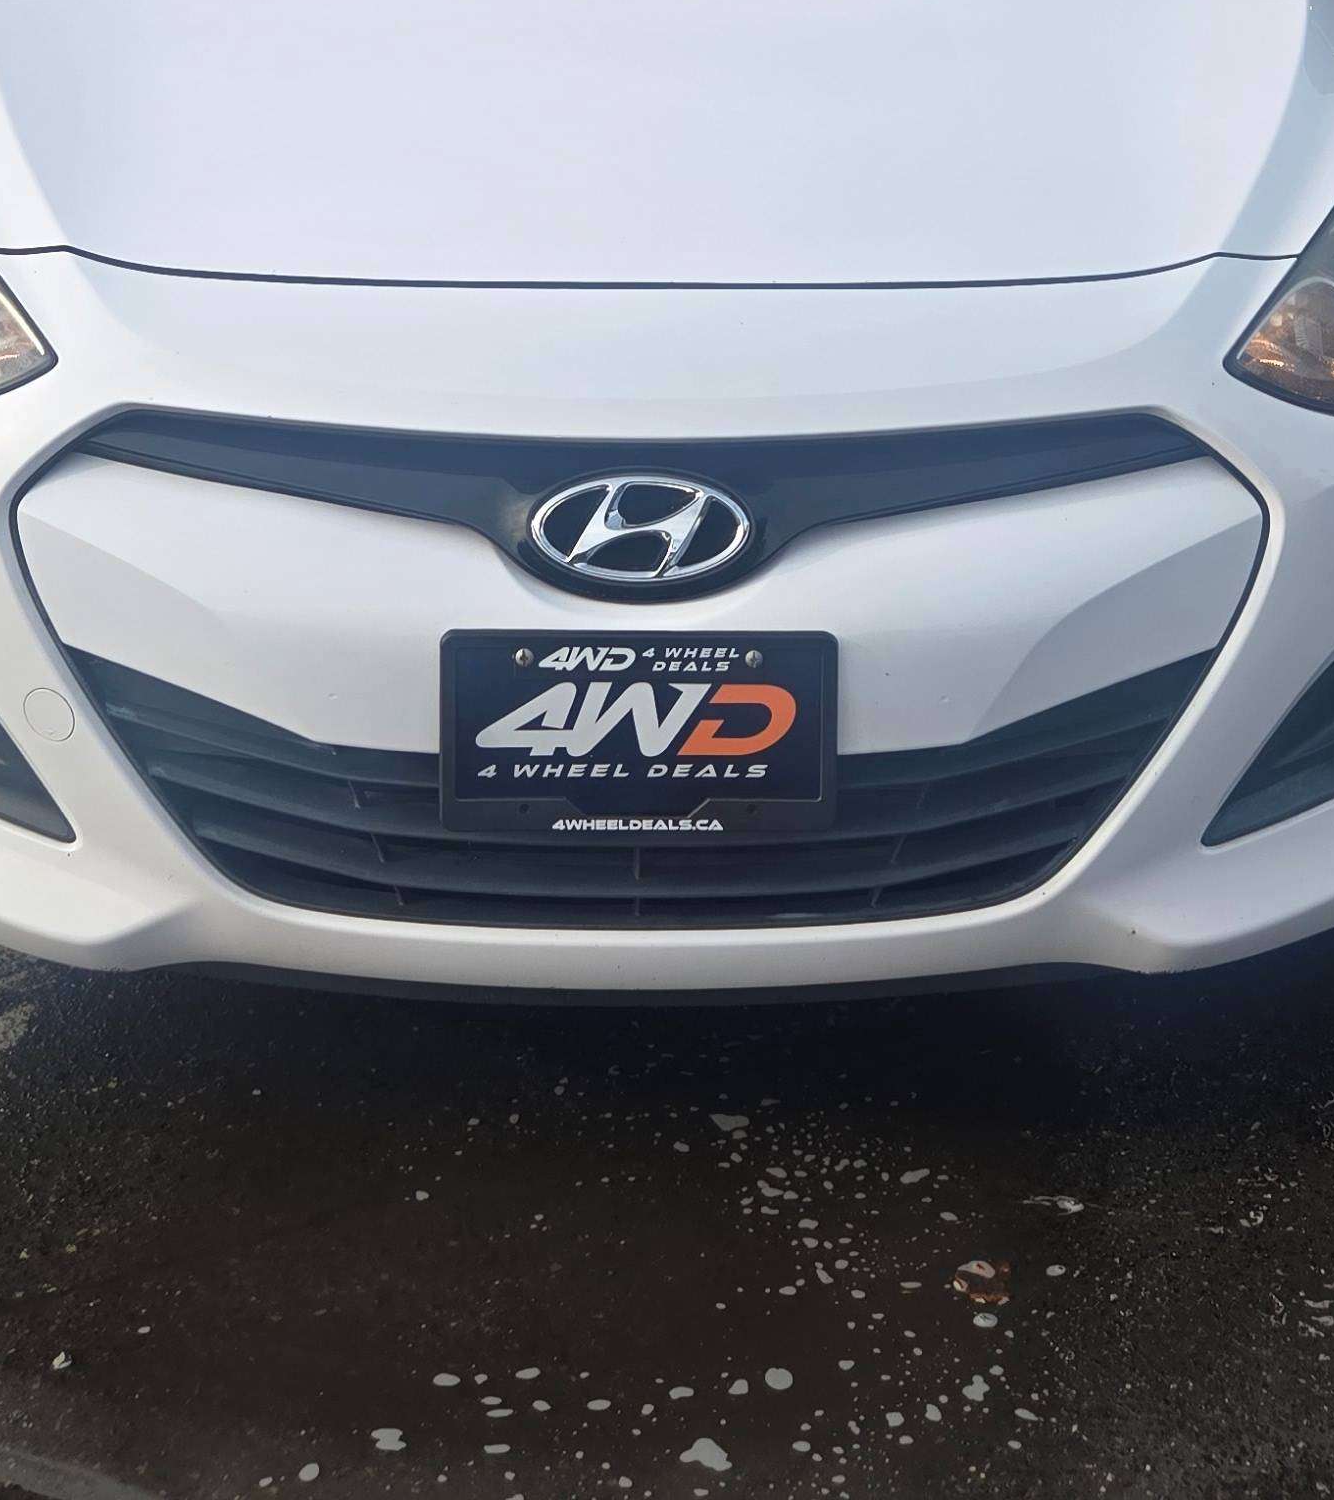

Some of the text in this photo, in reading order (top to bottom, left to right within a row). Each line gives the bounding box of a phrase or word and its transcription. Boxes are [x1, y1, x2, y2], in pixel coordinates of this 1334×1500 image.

[538, 646, 637, 672] 4WD
[642, 647, 740, 658] 4 WHEEL
[652, 661, 731, 672] DEALS
[475, 681, 797, 757] 4WD
[477, 764, 769, 778] 4 WHEEL DEALS
[552, 818, 724, 832] 4WHEELDEALS.CA
